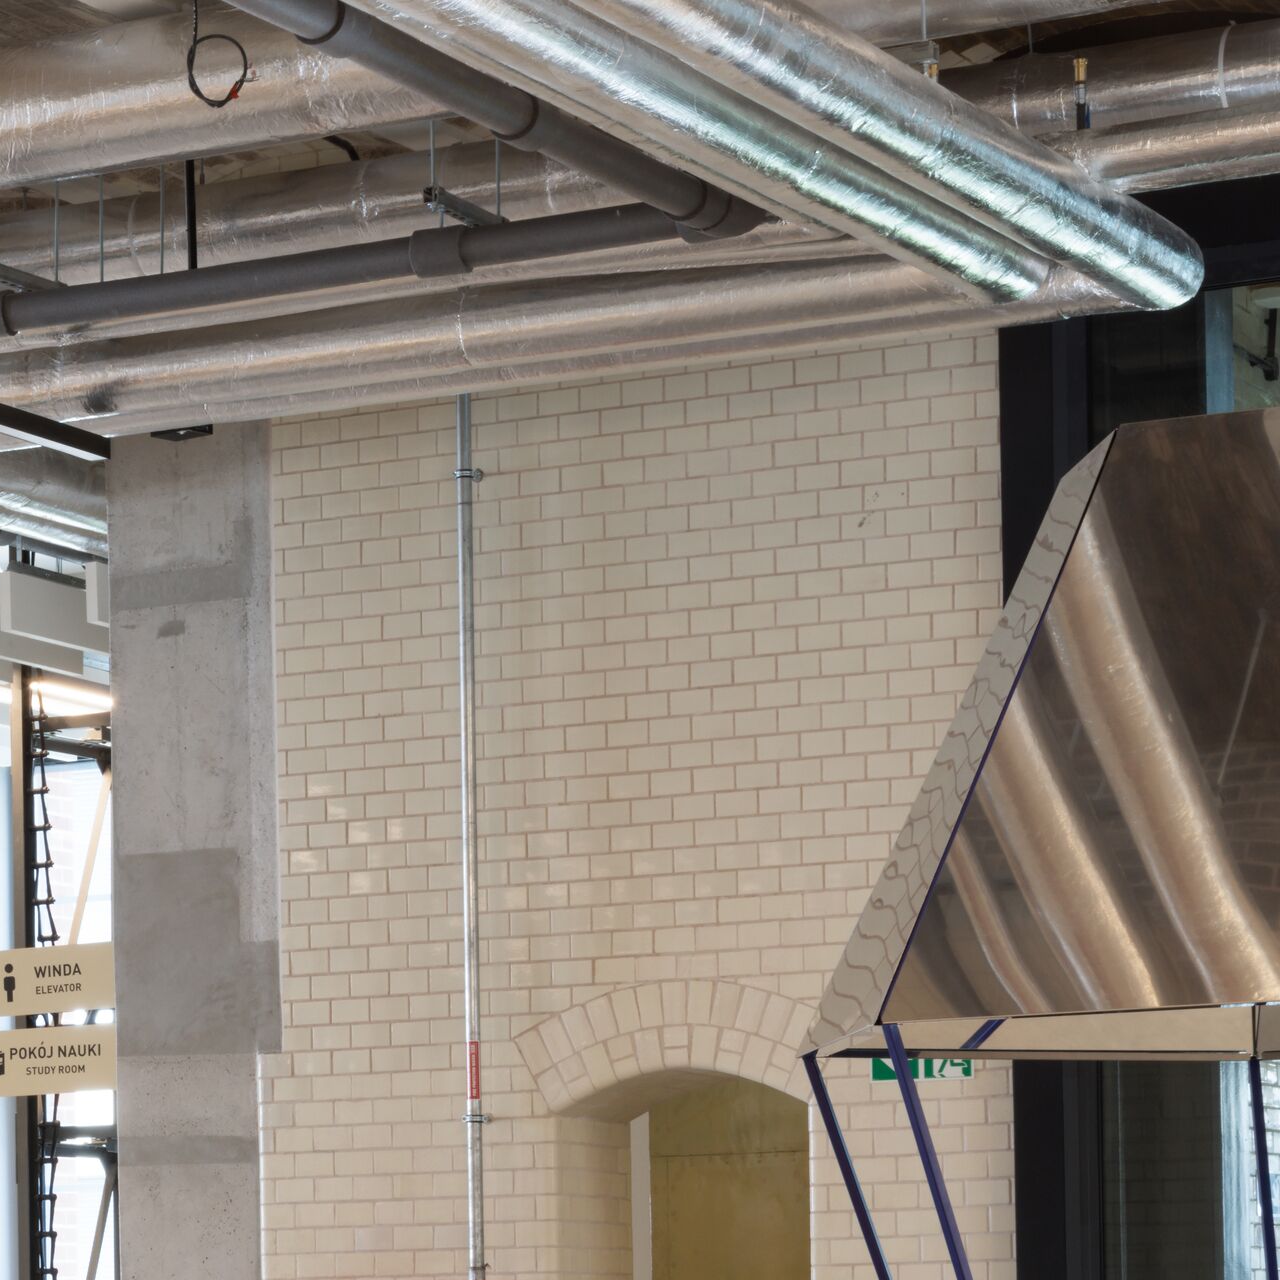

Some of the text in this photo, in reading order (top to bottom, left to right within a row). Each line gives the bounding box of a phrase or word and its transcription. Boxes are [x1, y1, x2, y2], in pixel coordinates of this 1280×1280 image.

[33, 962, 82, 979] WINDA
[35, 983, 82, 995] ELEVATOR
[9, 1041, 102, 1060] POKÓJ NAUKI
[25, 1064, 86, 1076] STUDY ROOM
